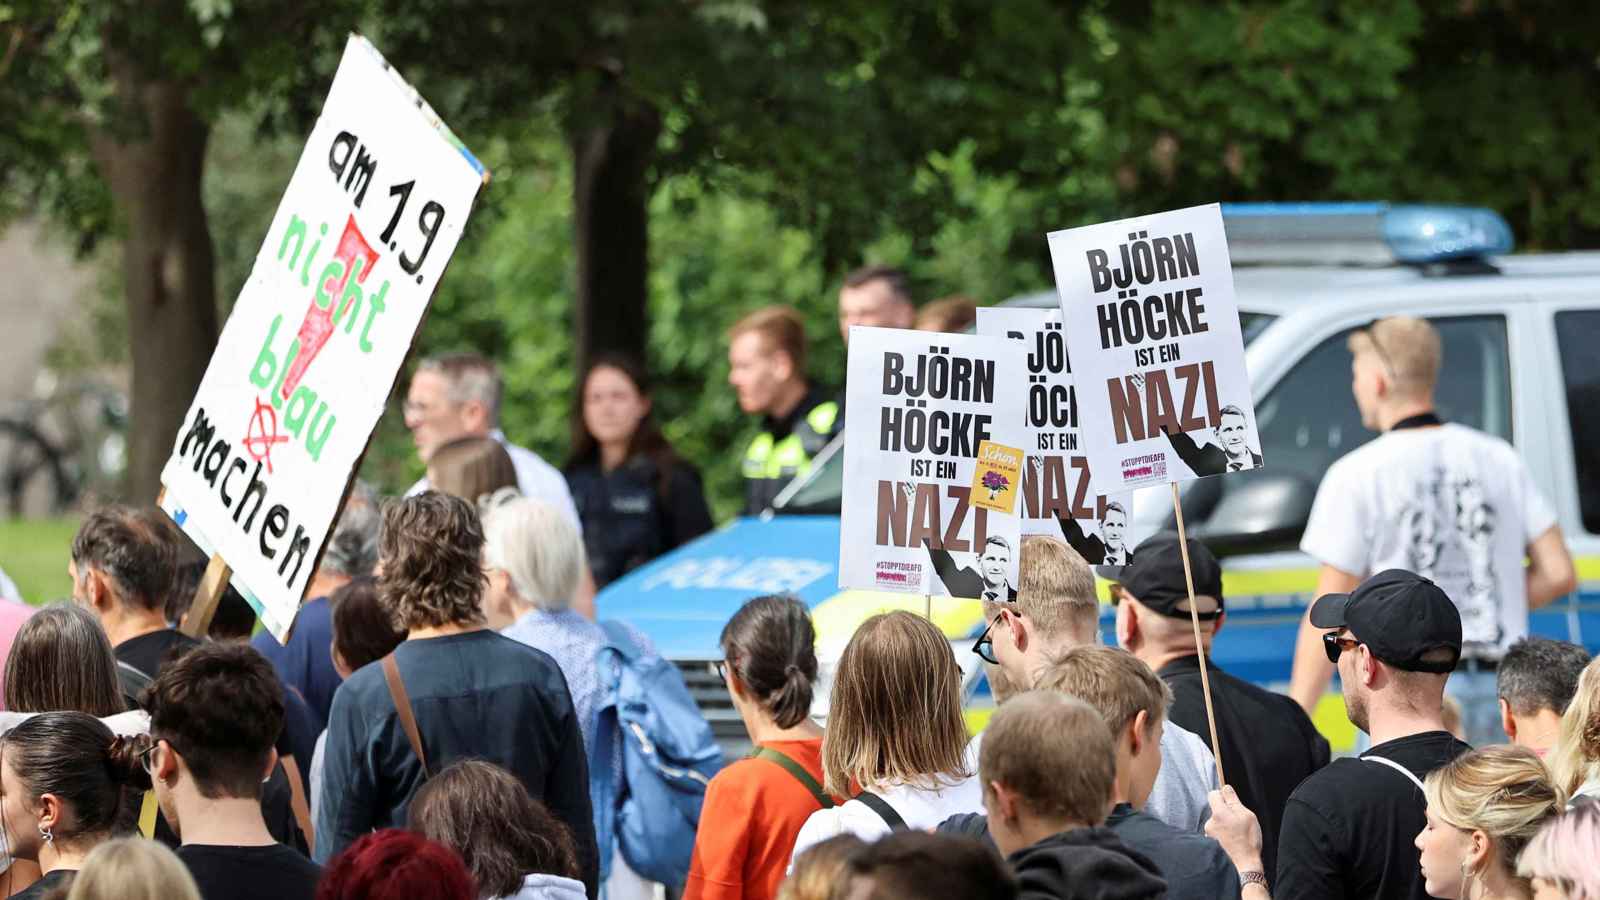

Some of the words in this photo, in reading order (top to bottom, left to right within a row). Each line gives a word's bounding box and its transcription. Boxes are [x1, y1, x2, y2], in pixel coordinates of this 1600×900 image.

[328, 130, 378, 210] am
[380, 180, 446, 285] 1.9.
[277, 213, 391, 353] nicht
[1086, 230, 1201, 294] BJÖRN
[1007, 322, 1072, 374] JÖ
[1096, 287, 1209, 350] HÖCKE
[881, 345, 996, 404] BJÖRN
[1134, 347, 1156, 368] IST
[1159, 342, 1181, 363] EIN
[249, 313, 337, 463] blau
[1106, 360, 1222, 445] NAZI
[879, 398, 993, 459] HÖCKE
[1037, 432, 1055, 451] IST
[1059, 432, 1078, 451] EIN
[179, 407, 311, 590] machen
[910, 458, 932, 478] IST
[935, 459, 957, 480] EIN
[875, 479, 989, 554] NAZI
